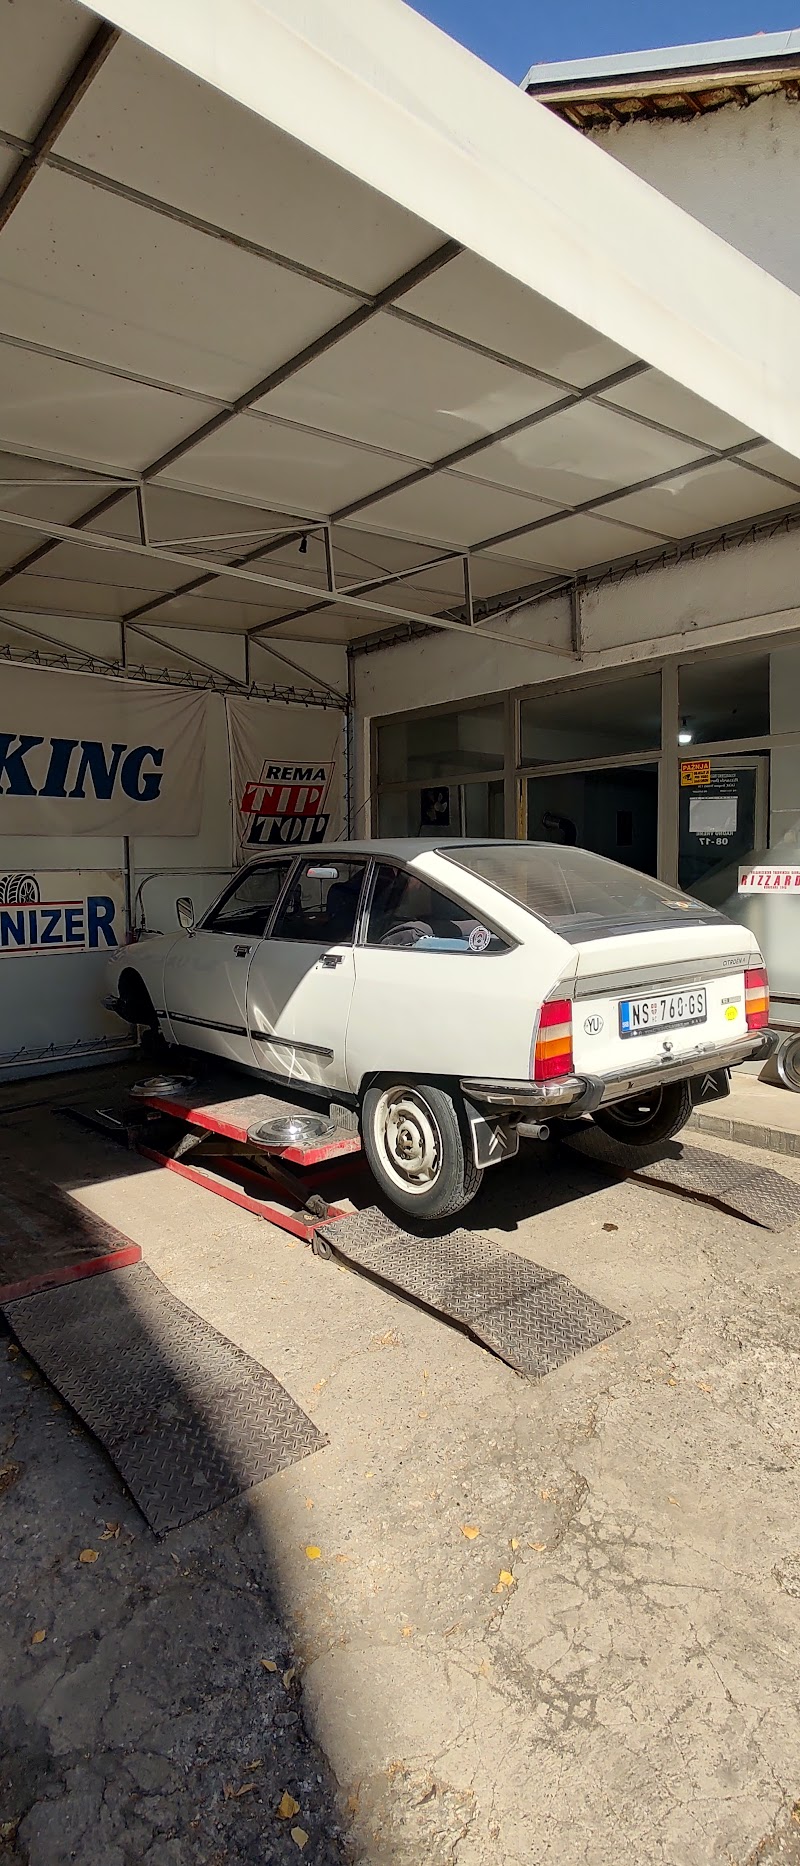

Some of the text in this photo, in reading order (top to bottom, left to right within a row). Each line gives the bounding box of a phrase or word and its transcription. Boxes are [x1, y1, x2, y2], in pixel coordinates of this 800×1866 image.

[266, 766, 326, 780] REMA
[247, 785, 320, 812] TIP
[256, 816, 326, 842] TOP
[587, 1017, 600, 1032] YU
[632, 1003, 649, 1026] NS
